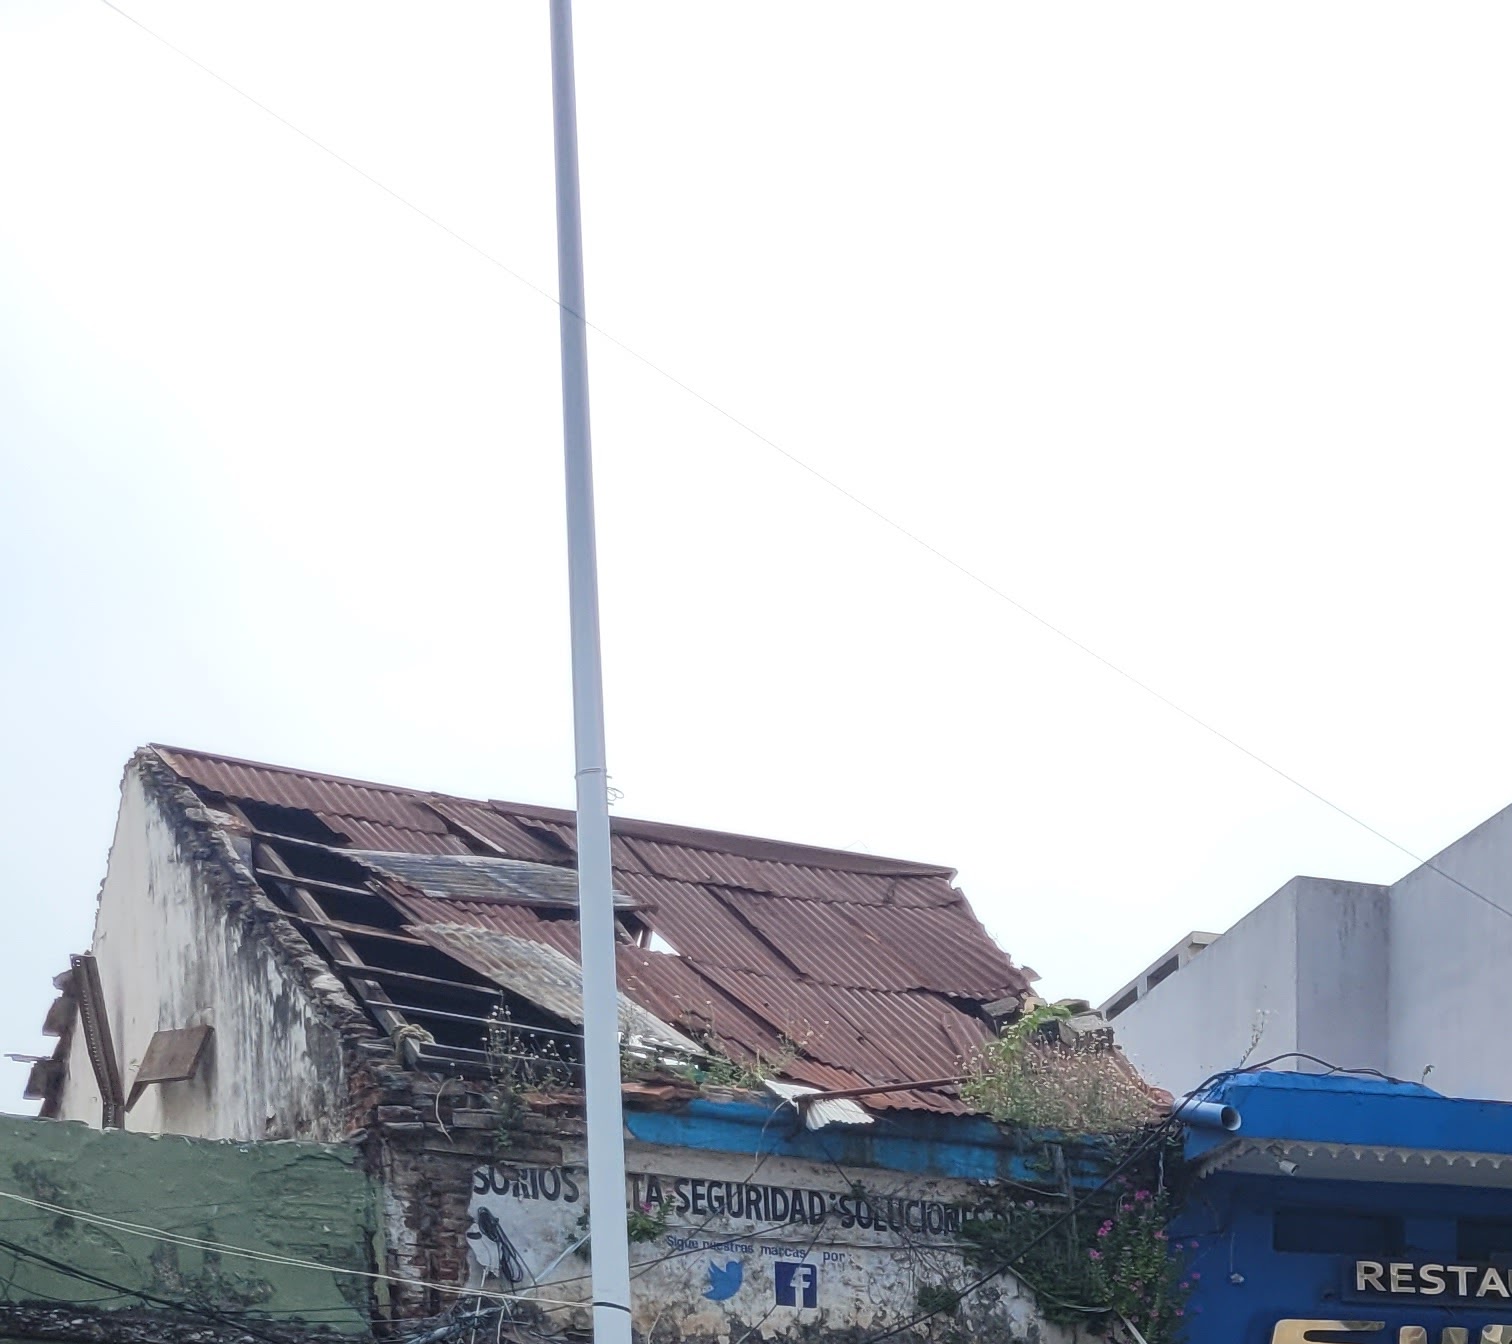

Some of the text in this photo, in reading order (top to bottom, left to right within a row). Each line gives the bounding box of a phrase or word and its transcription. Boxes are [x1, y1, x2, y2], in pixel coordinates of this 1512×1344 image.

[673, 1177, 826, 1226] SEGURIDAD
[666, 1234, 699, 1251] Sigue
[760, 1245, 806, 1258] marcas
